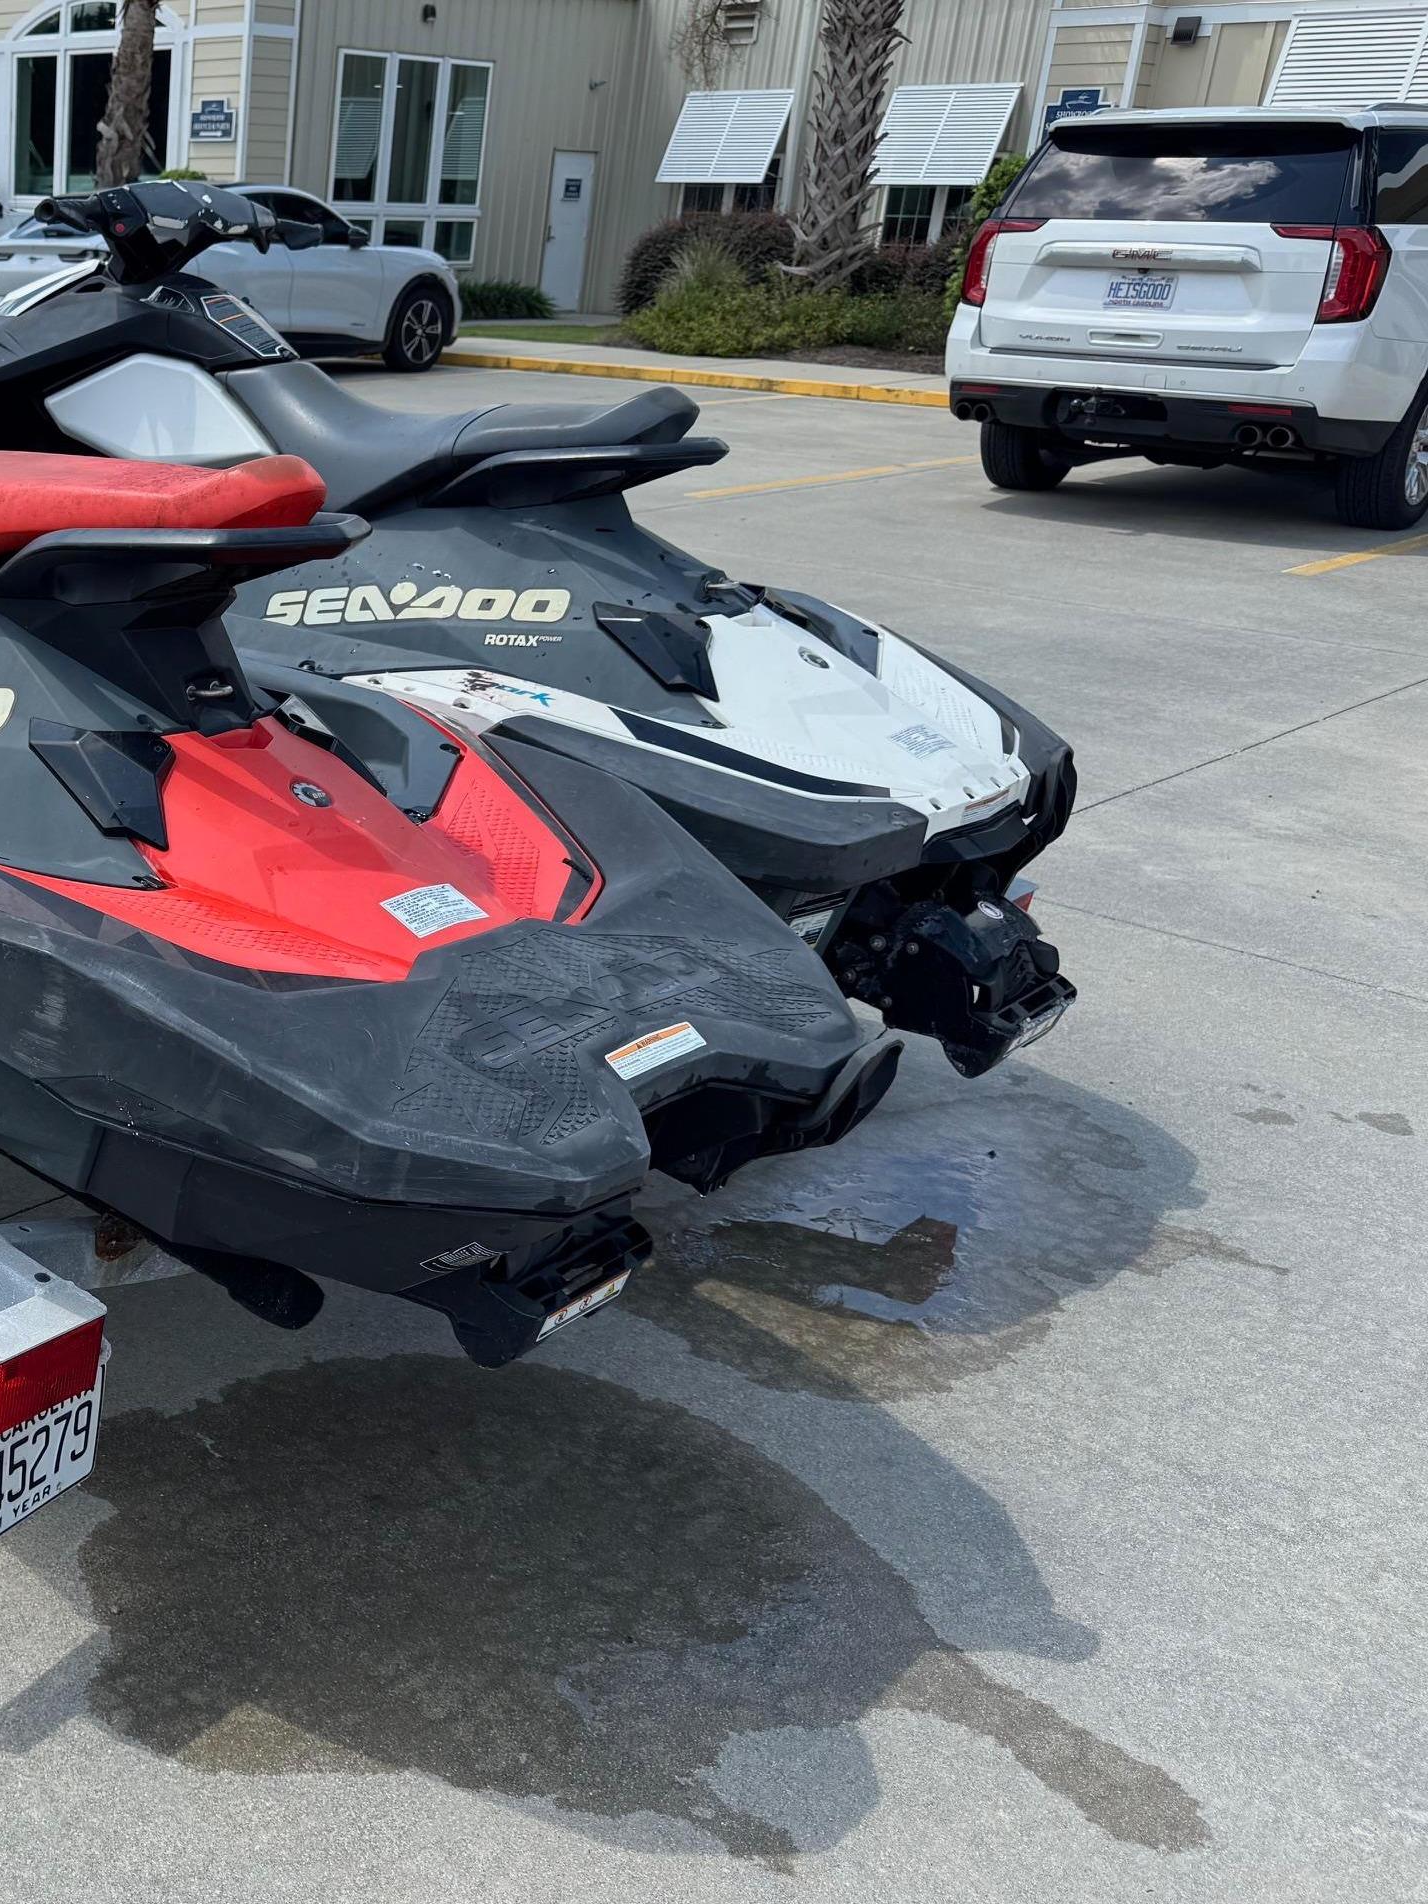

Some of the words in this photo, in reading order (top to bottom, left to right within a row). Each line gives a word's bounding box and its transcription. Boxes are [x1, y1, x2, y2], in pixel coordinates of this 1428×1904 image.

[1112, 249, 1172, 261] GMC
[1107, 281, 1172, 301] HEISGOOD
[484, 633, 539, 647] ROTAX
[12, 1484, 51, 1518] YEAR
